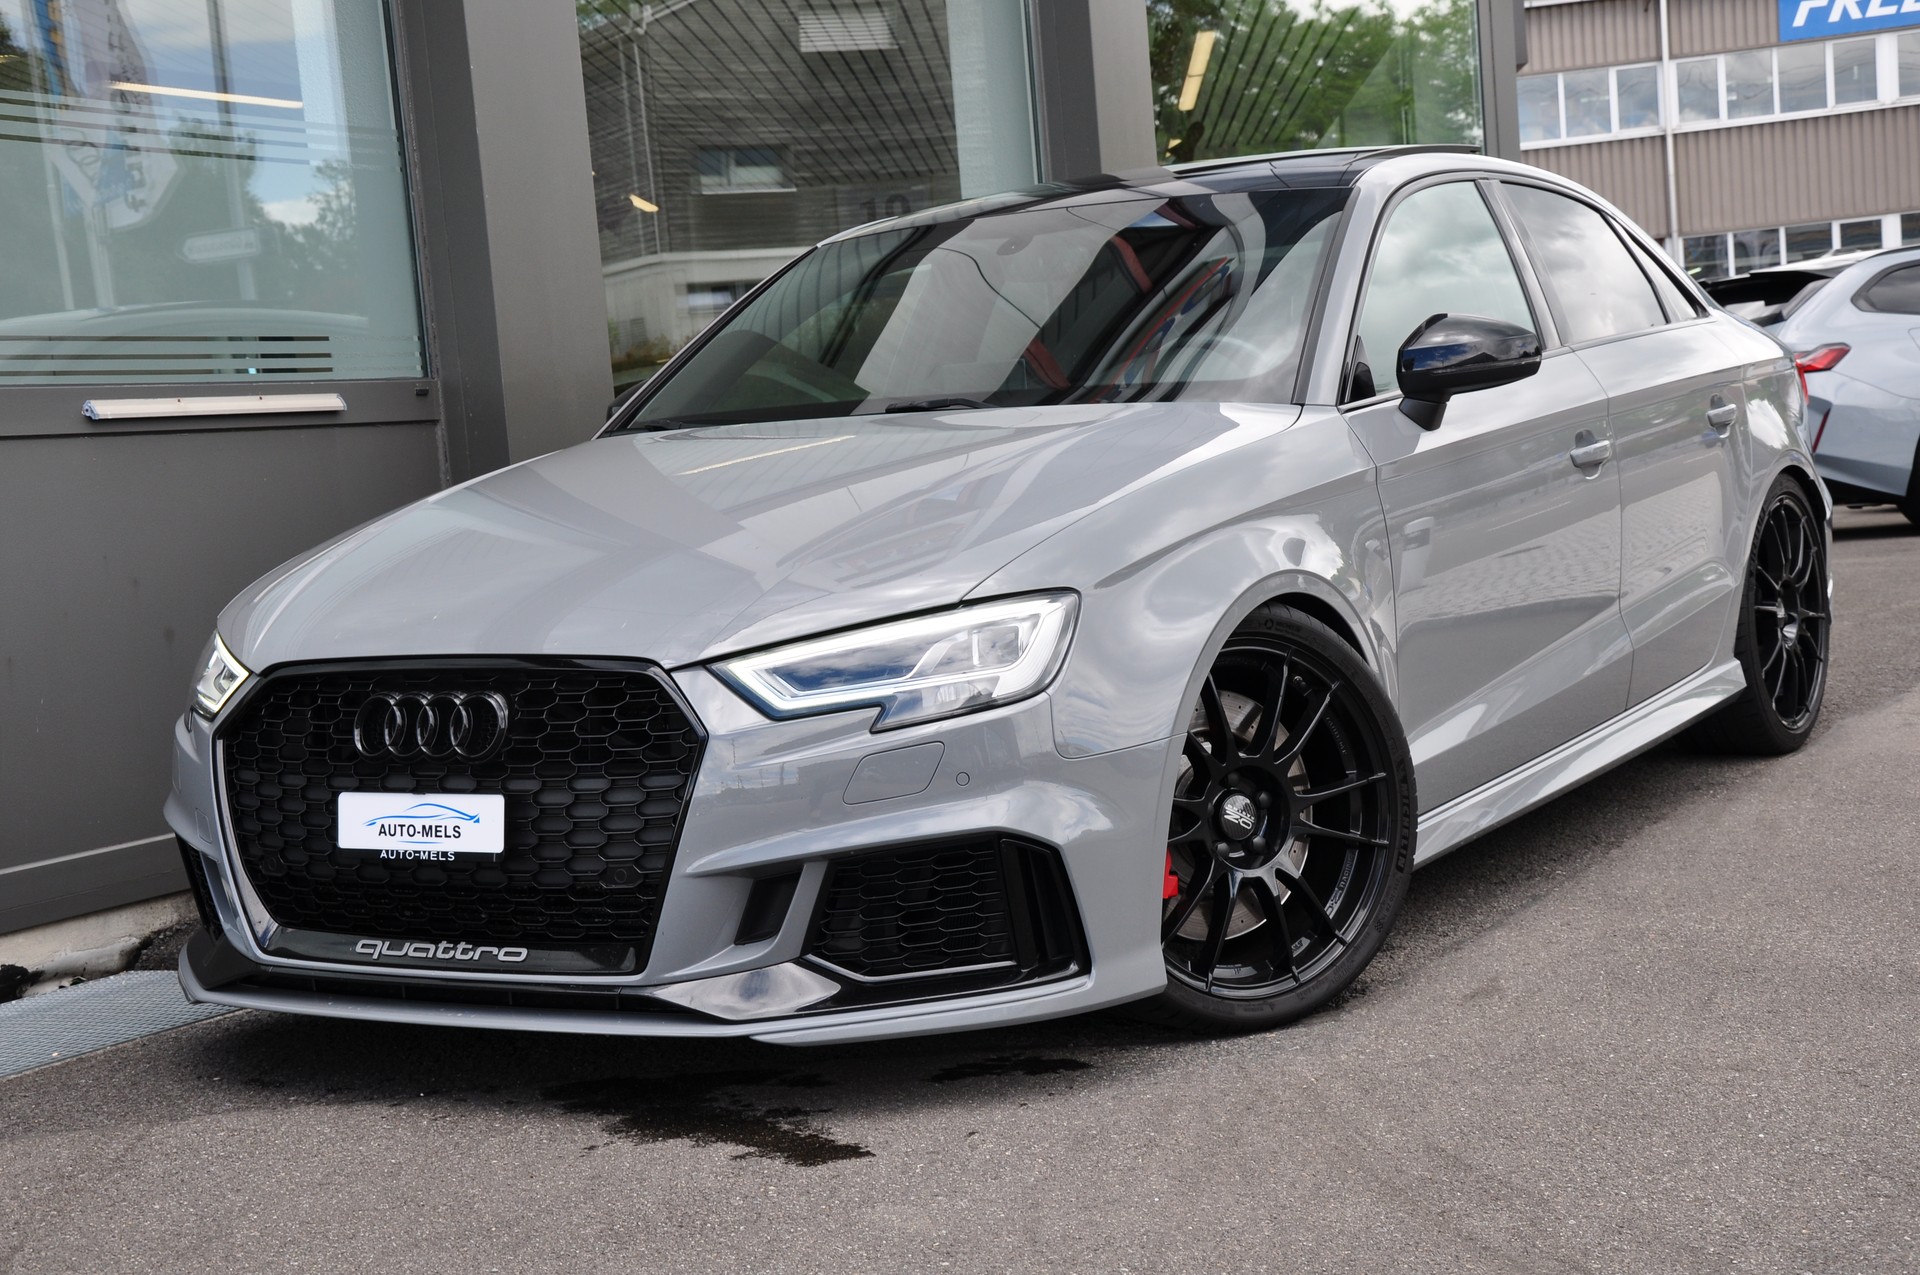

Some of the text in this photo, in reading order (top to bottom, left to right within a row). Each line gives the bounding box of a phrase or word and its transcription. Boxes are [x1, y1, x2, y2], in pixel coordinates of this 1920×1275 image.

[378, 823, 461, 839] AUTO-MELS
[1396, 783, 1411, 868] MICHELIN
[380, 849, 455, 861] AUTO-MELS
[355, 939, 528, 962] quattro
